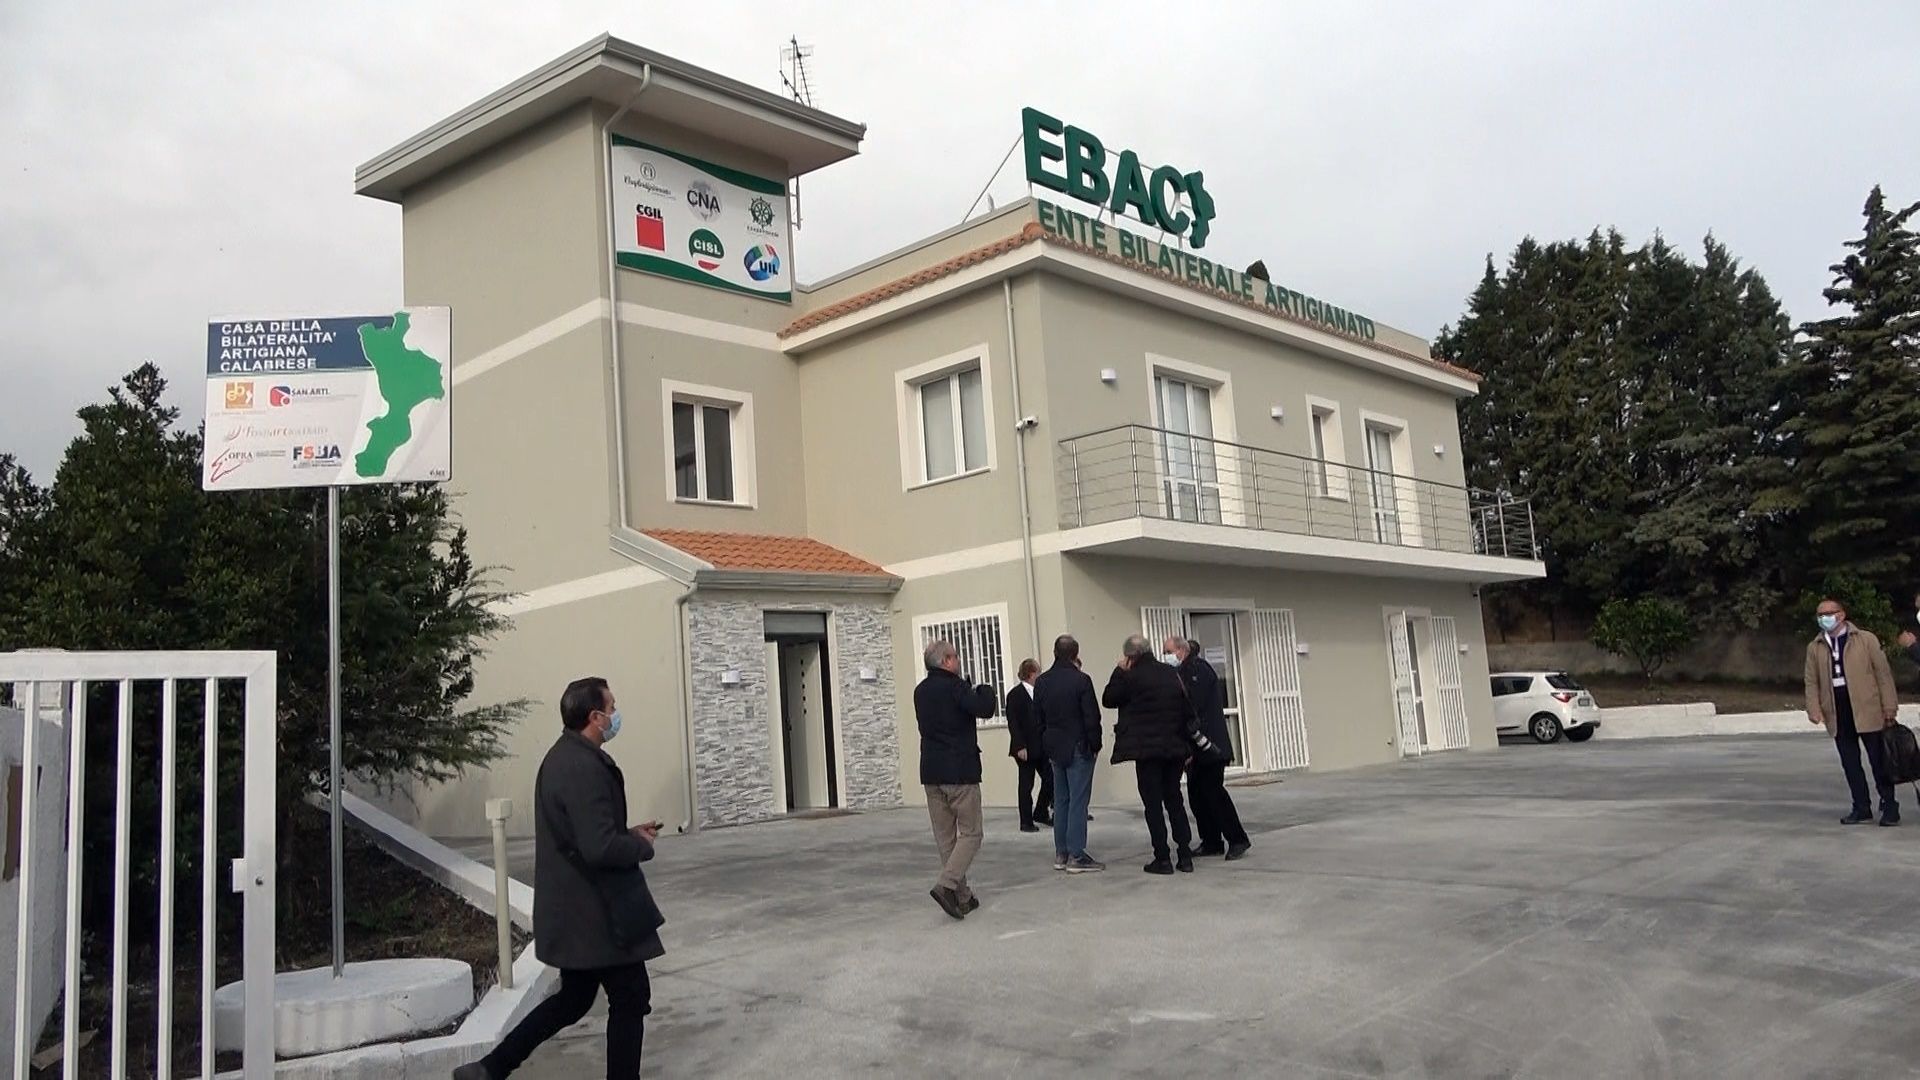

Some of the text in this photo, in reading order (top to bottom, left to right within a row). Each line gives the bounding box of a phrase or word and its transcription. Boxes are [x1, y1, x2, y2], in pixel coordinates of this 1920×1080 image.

[1022, 106, 1190, 235] EBAC
[687, 189, 720, 213] CNA
[636, 204, 663, 219] CGIL
[693, 238, 721, 255] CISL
[760, 260, 779, 275] UIL
[1038, 198, 1376, 341] ENTE BILATERALE ARTIGIANATO
[221, 320, 321, 335] CASA DELLA
[221, 332, 336, 347] BILATERALITA'
[220, 346, 308, 360] ARTIGIANA
